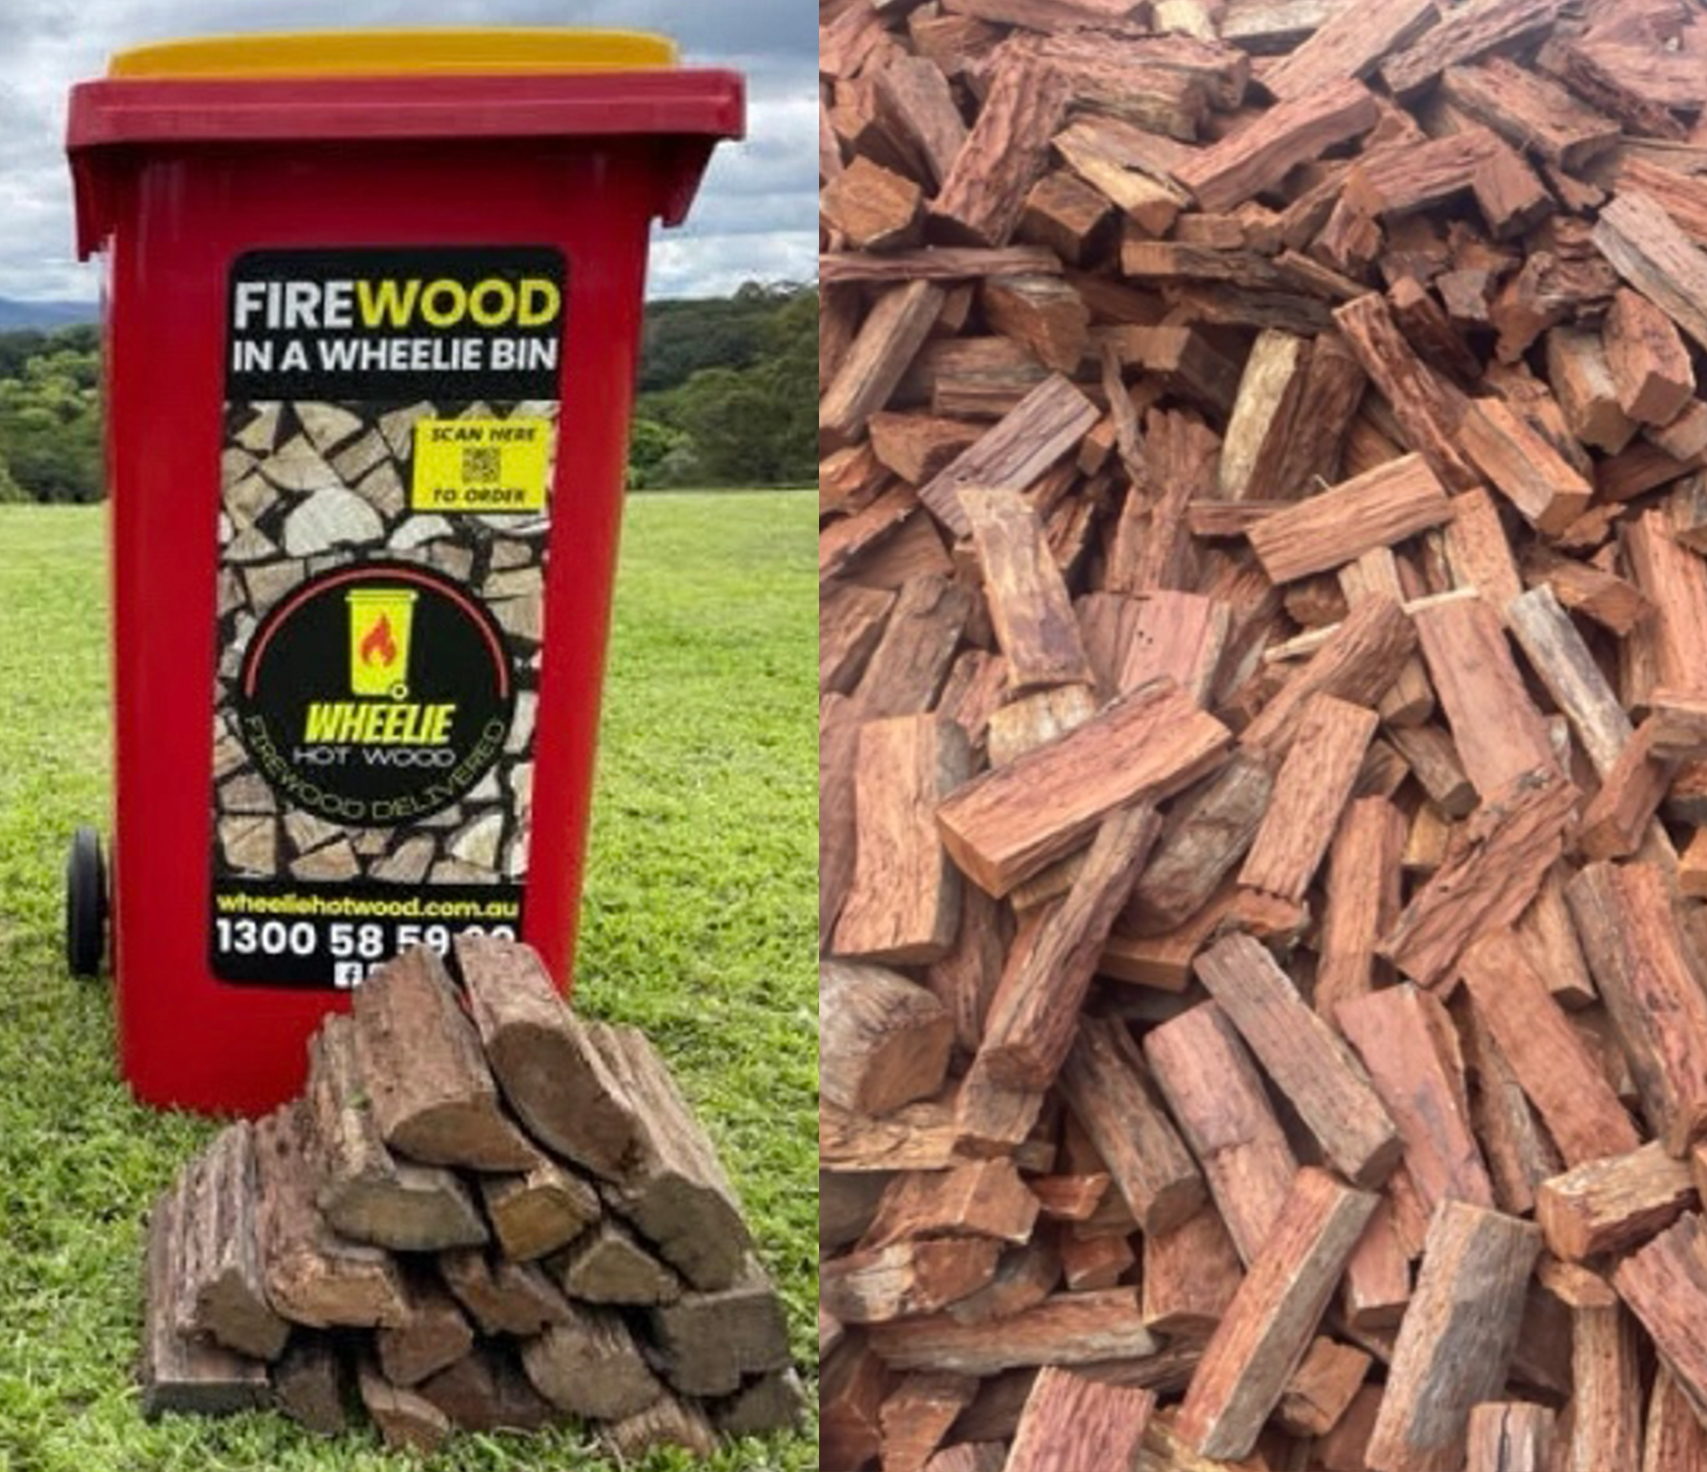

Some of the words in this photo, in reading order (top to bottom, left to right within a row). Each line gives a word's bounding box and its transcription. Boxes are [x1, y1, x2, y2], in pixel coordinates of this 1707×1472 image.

[233, 279, 562, 329] FIREWOOD
[232, 341, 272, 372] IN
[280, 341, 309, 372] A
[317, 339, 482, 371] WHEELIE
[490, 339, 557, 370] BIN
[430, 427, 482, 442] SCAN
[490, 427, 537, 442] HERE
[433, 489, 458, 502] TO
[464, 489, 526, 503] ORDER
[304, 704, 456, 744] WHEELIE
[245, 714, 364, 819] FIREWOOD
[371, 720, 504, 820] DELIVERED
[293, 747, 350, 765] HOT
[363, 747, 455, 766] WOOD
[216, 893, 519, 917] wheeliehotwood.com.au
[216, 919, 316, 955] 1300
[330, 923, 384, 957] 58
